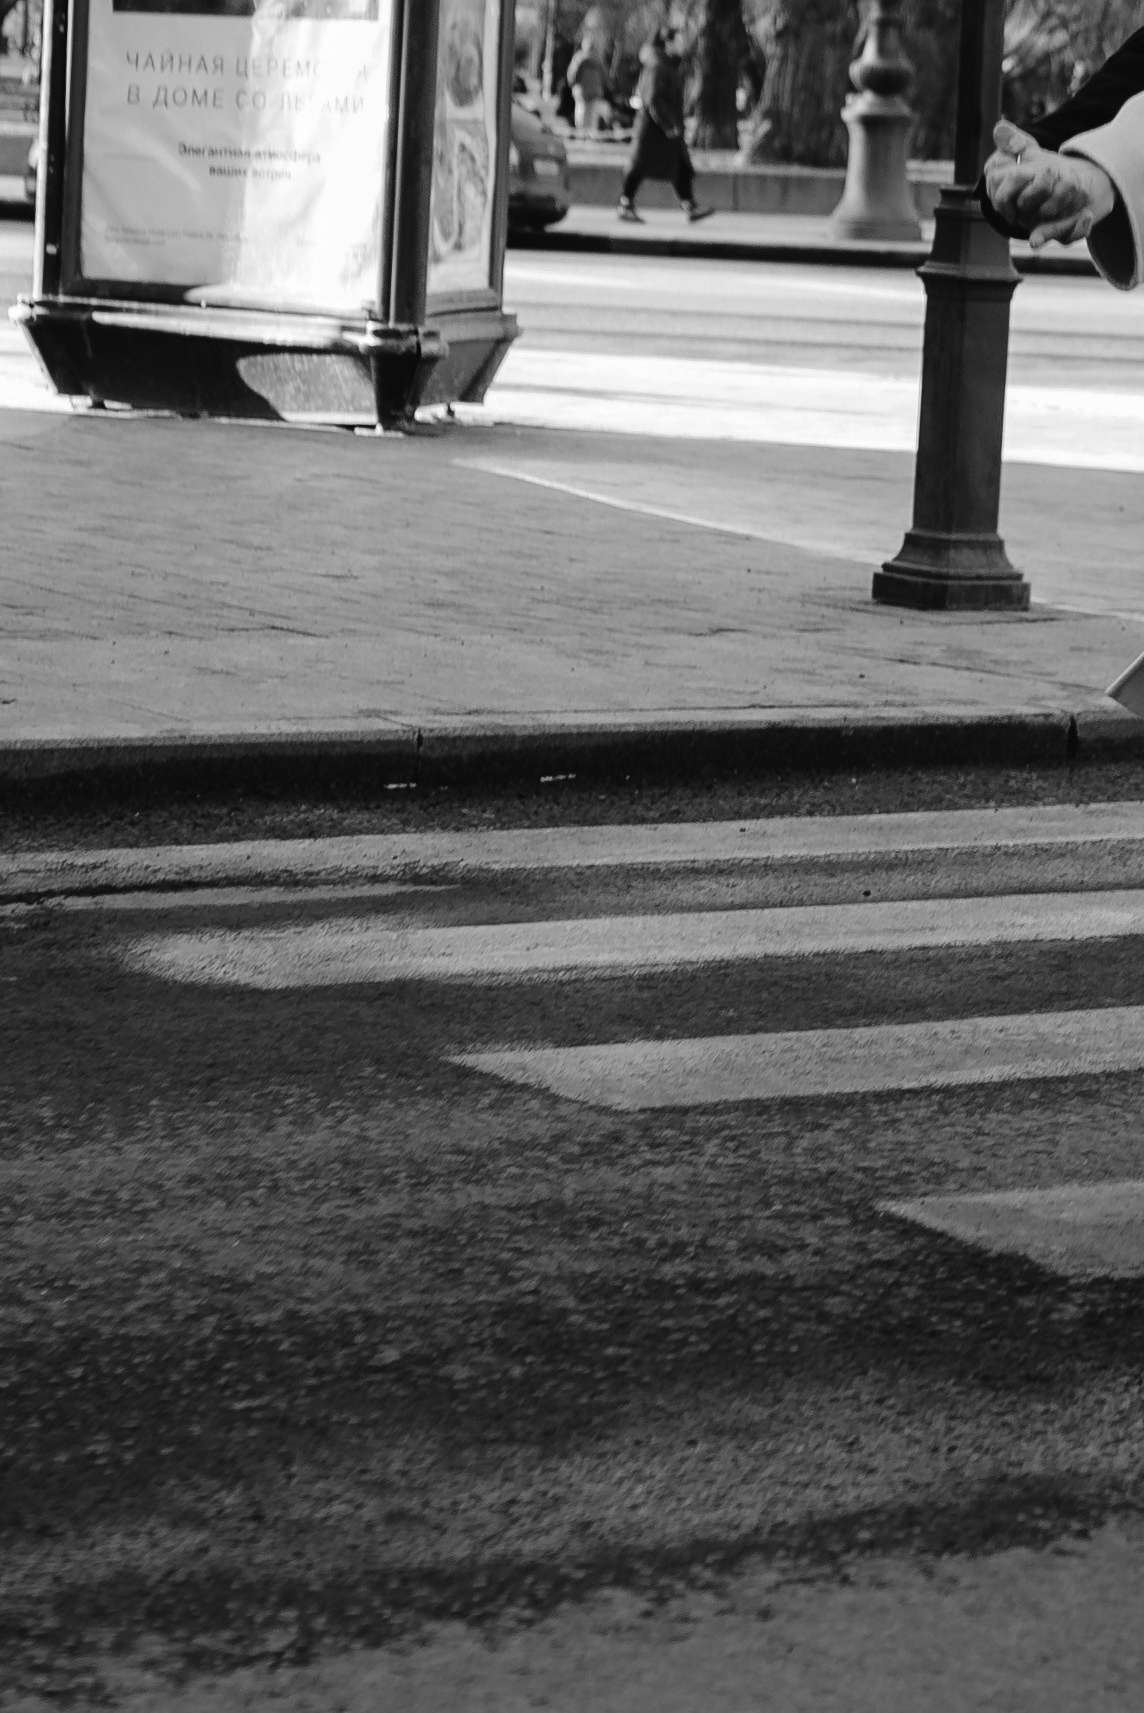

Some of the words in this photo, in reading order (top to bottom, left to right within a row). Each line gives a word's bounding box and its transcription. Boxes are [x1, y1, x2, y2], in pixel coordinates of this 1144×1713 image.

[126, 49, 225, 76] ЧАЙНАЯ
[126, 83, 141, 105] В
[152, 85, 225, 110] ДОМЕ
